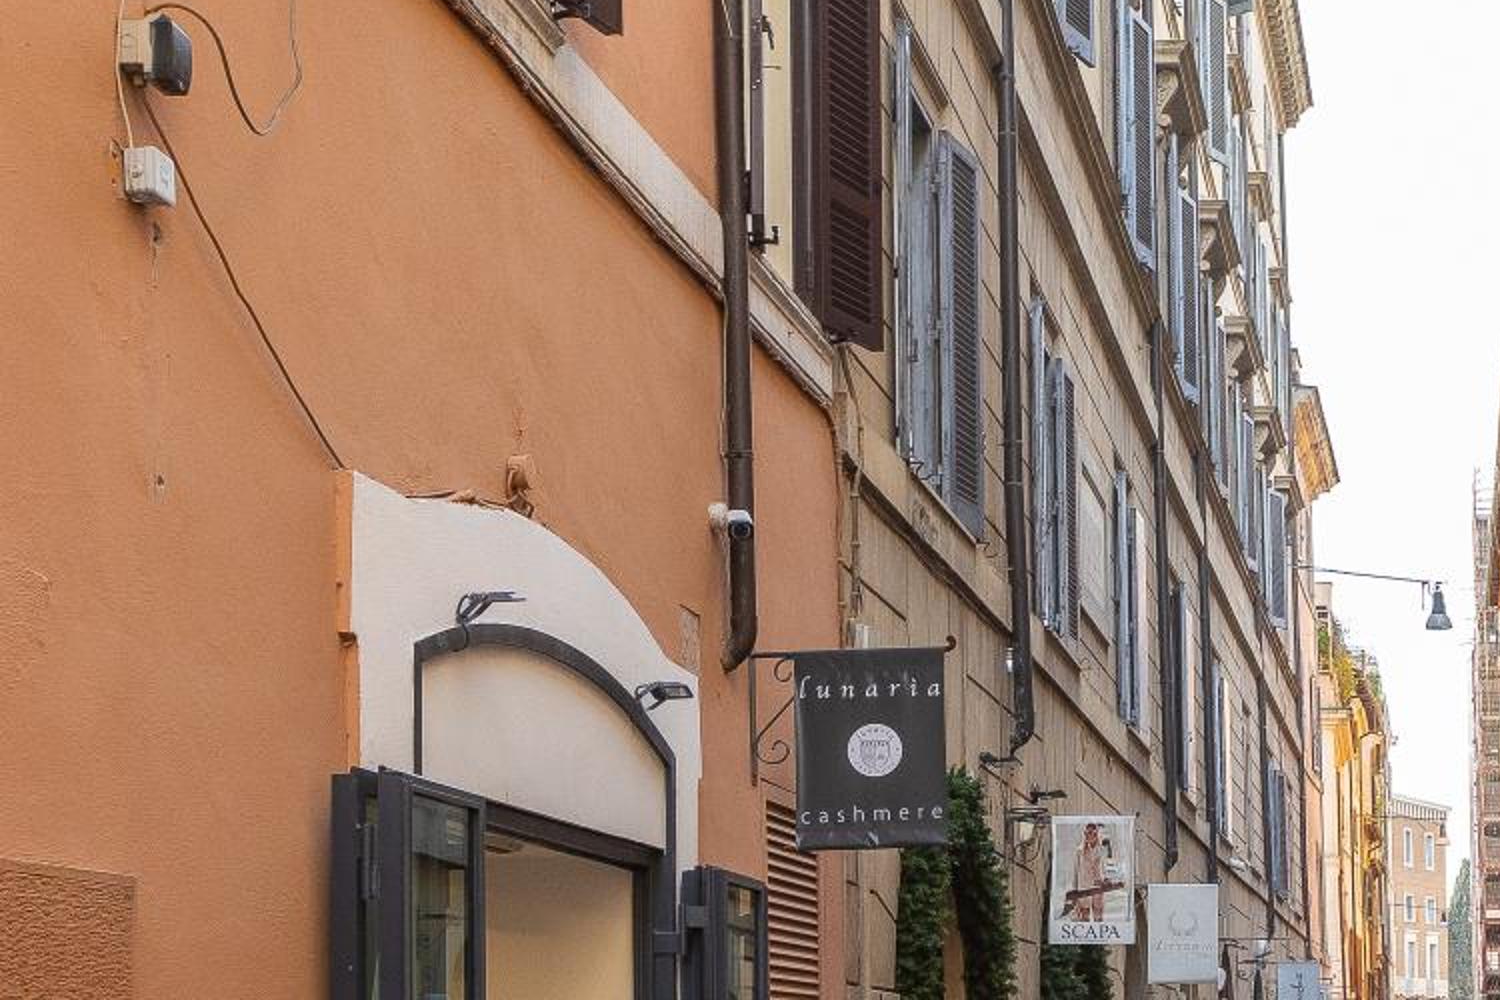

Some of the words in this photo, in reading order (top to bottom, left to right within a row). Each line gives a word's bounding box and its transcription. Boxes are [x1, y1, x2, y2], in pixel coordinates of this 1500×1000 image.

[799, 675, 941, 699] lunaria
[801, 804, 943, 825] cashmere
[1061, 923, 1121, 939] SCAPA
